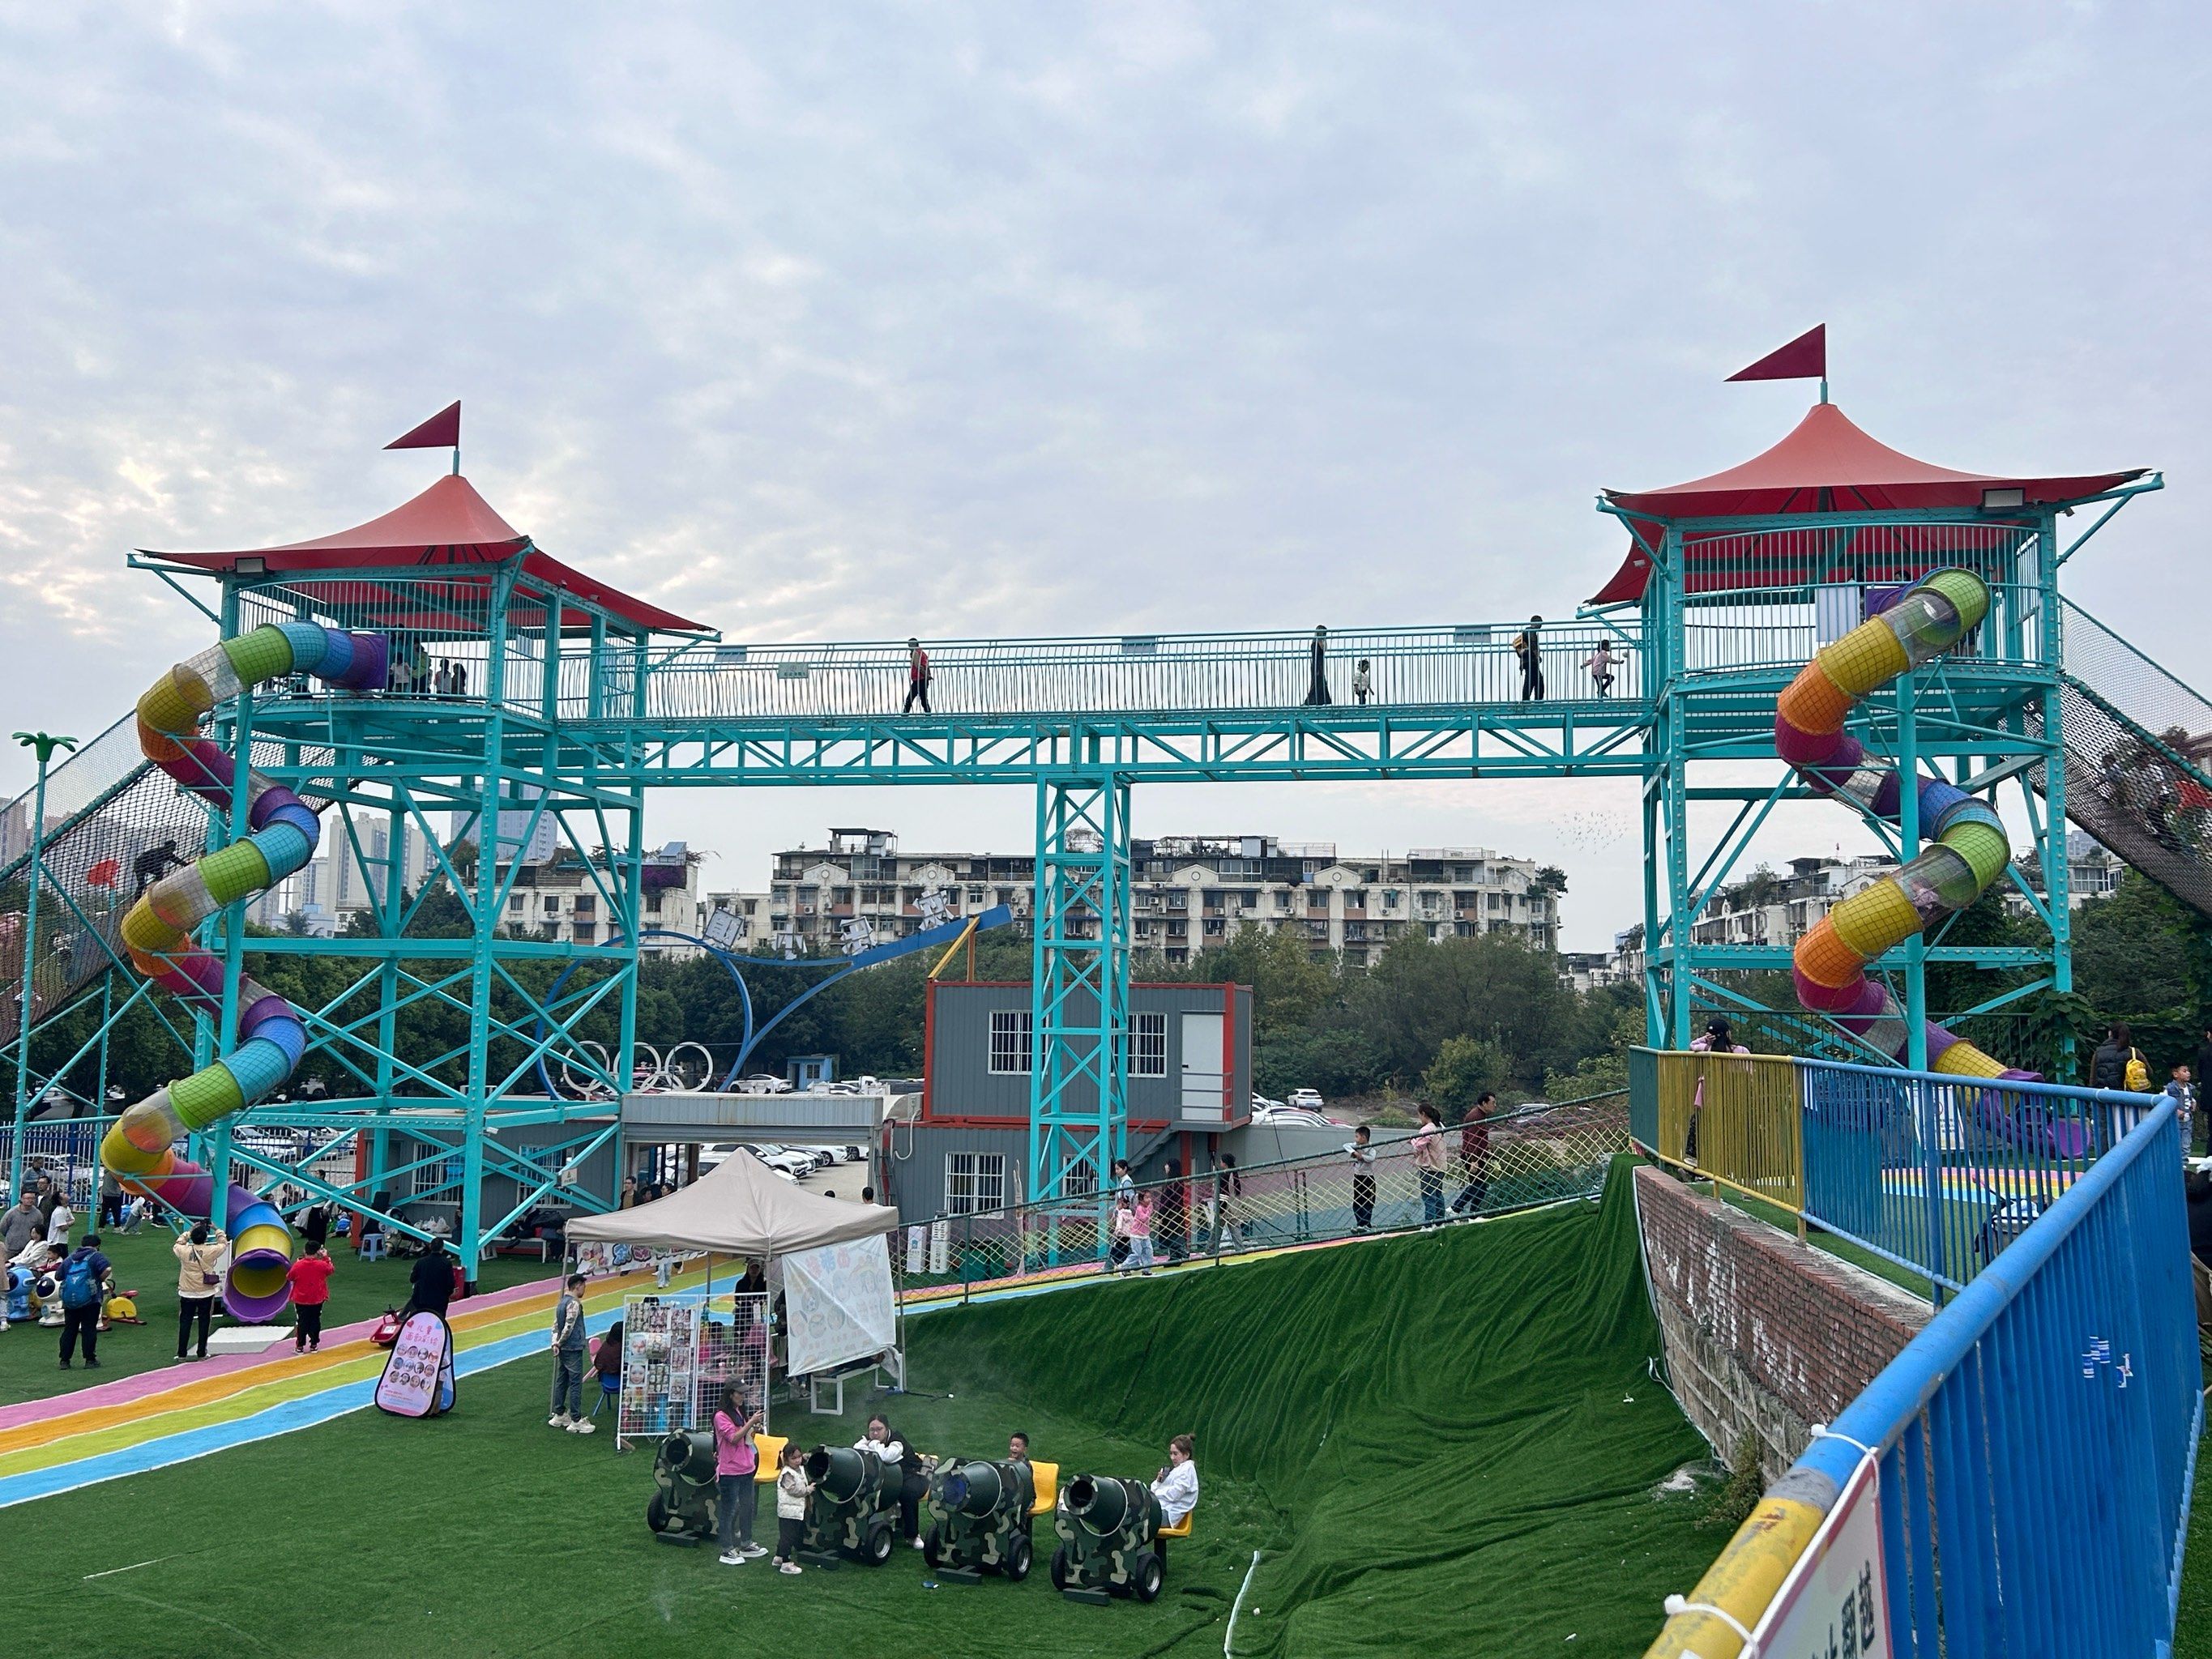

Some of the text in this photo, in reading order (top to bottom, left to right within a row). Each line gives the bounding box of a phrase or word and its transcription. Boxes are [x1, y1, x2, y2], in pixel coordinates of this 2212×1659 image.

[416, 1324, 432, 1335] 儿童
[405, 1332, 438, 1346] 面部彩绘
